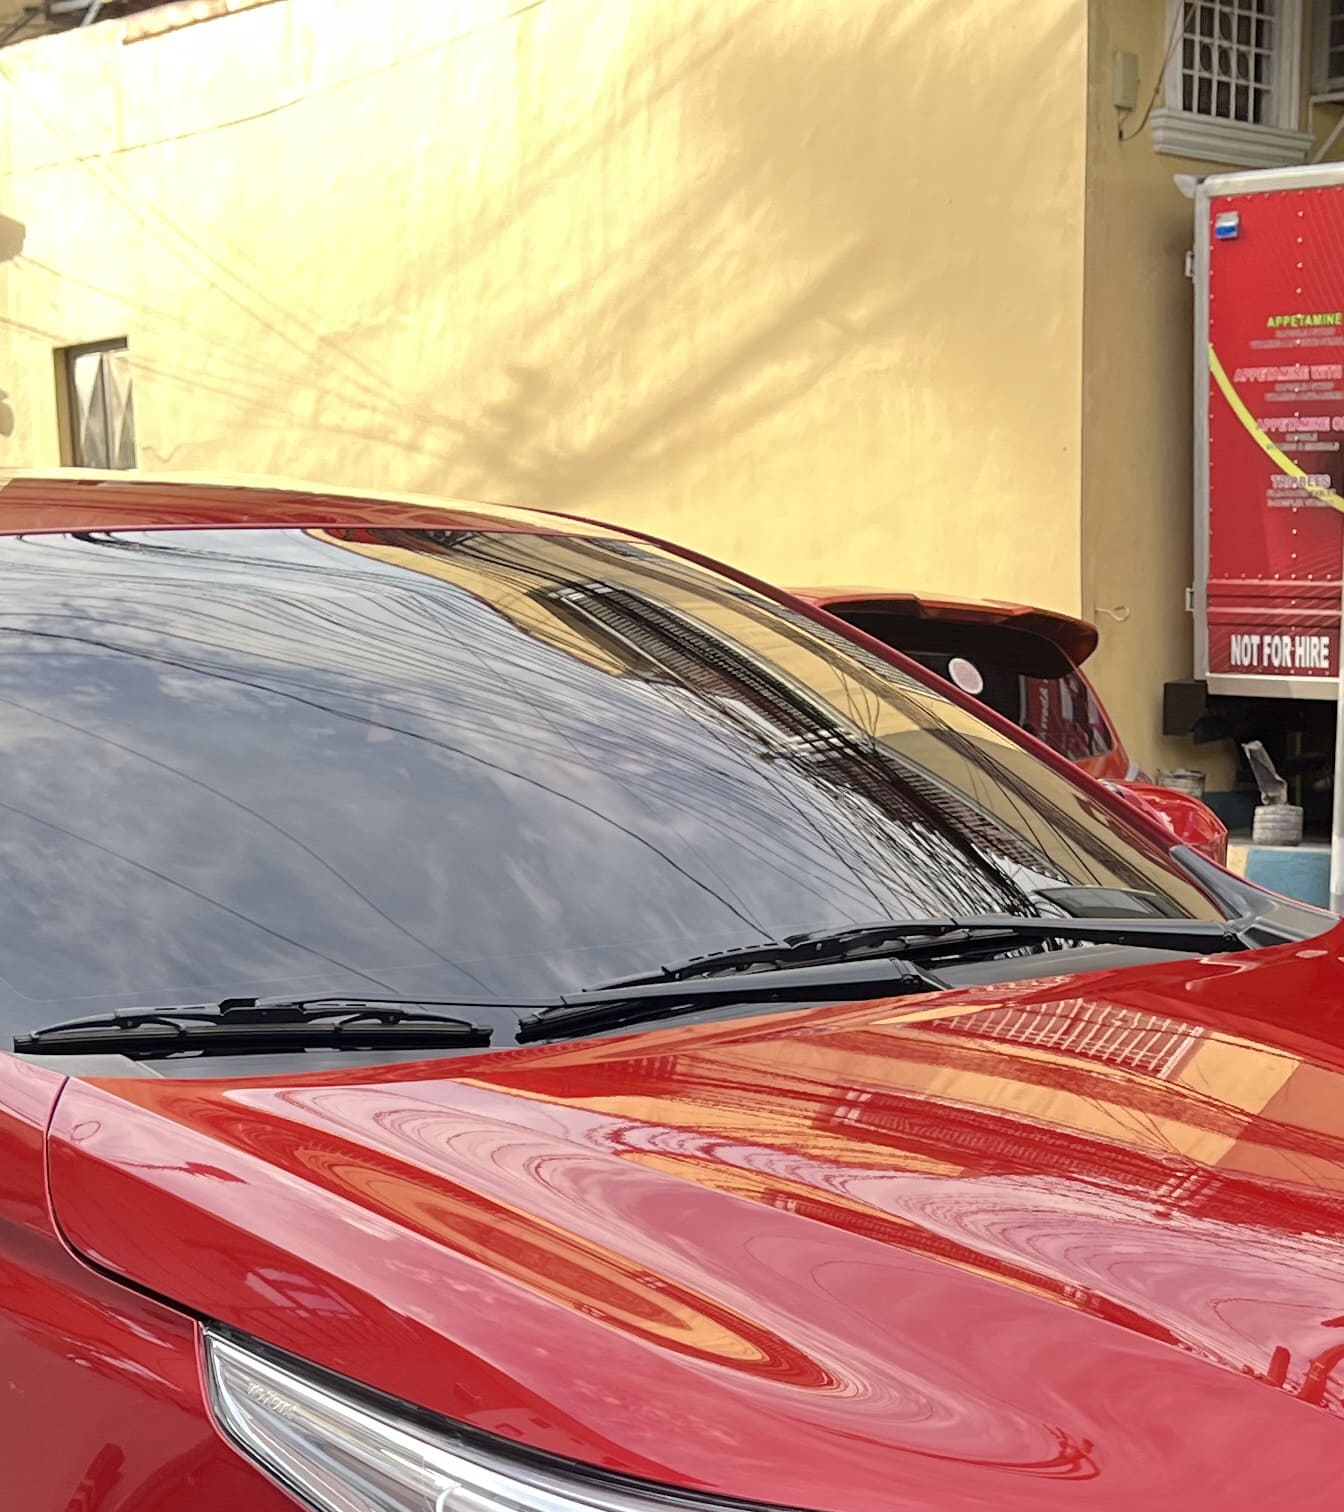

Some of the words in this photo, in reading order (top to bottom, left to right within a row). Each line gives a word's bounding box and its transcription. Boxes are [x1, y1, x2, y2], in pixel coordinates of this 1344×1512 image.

[1267, 312, 1343, 328] APPETAMINE
[1231, 634, 1260, 667] NOT
[1262, 635, 1292, 668] FOR
[1294, 636, 1330, 669] HIRE
